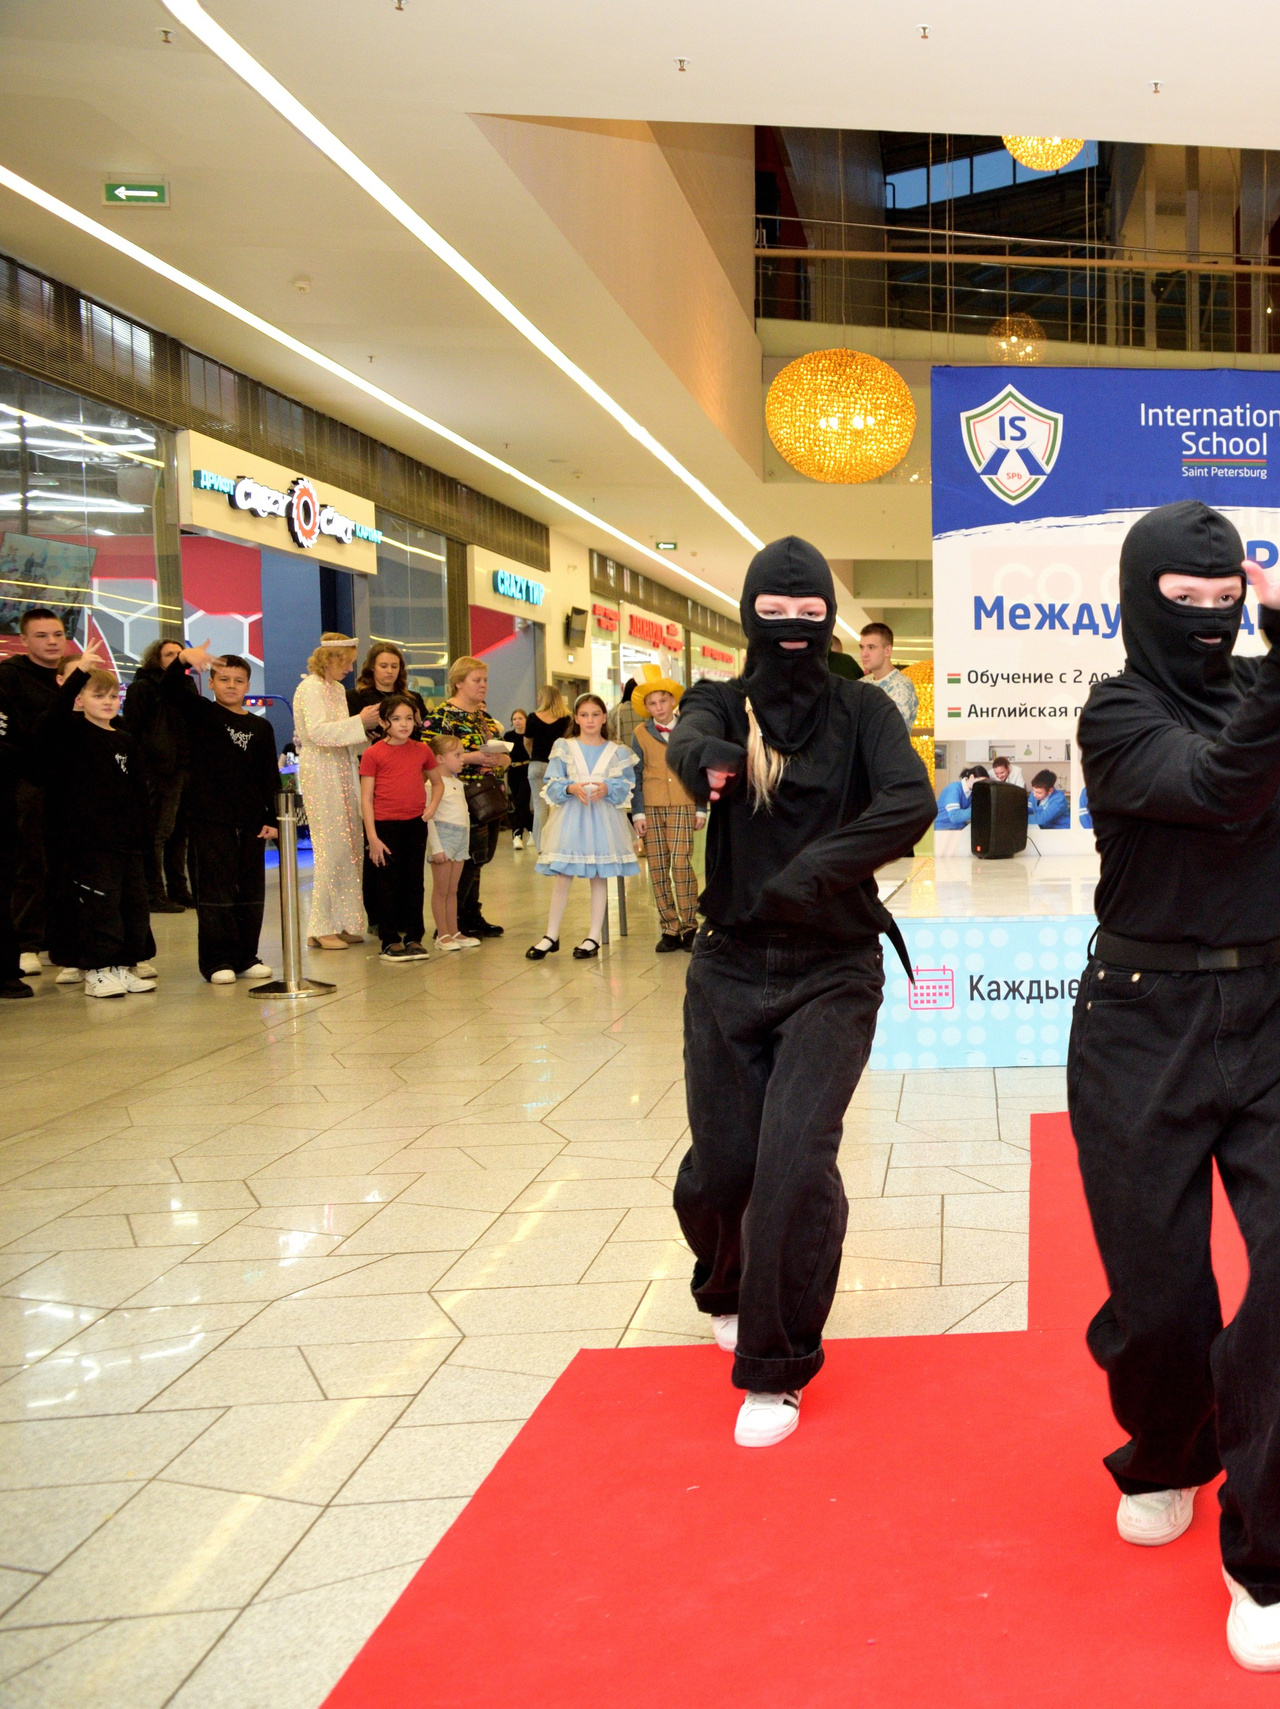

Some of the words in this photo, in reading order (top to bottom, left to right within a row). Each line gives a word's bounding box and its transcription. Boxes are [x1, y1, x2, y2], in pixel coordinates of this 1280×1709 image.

[998, 416, 1027, 441] IS
[1181, 431, 1267, 456] School
[199, 469, 236, 496] ДРИФТ
[1181, 466, 1208, 478] Saint
[1211, 467, 1267, 480] Petersburg
[496, 568, 527, 602] CRAZY
[967, 670, 1054, 687] Обучение
[1059, 673, 1067, 684] с
[1073, 669, 1083, 684] 2
[967, 703, 1069, 718] Английская
[969, 974, 1080, 1004] Каждые
